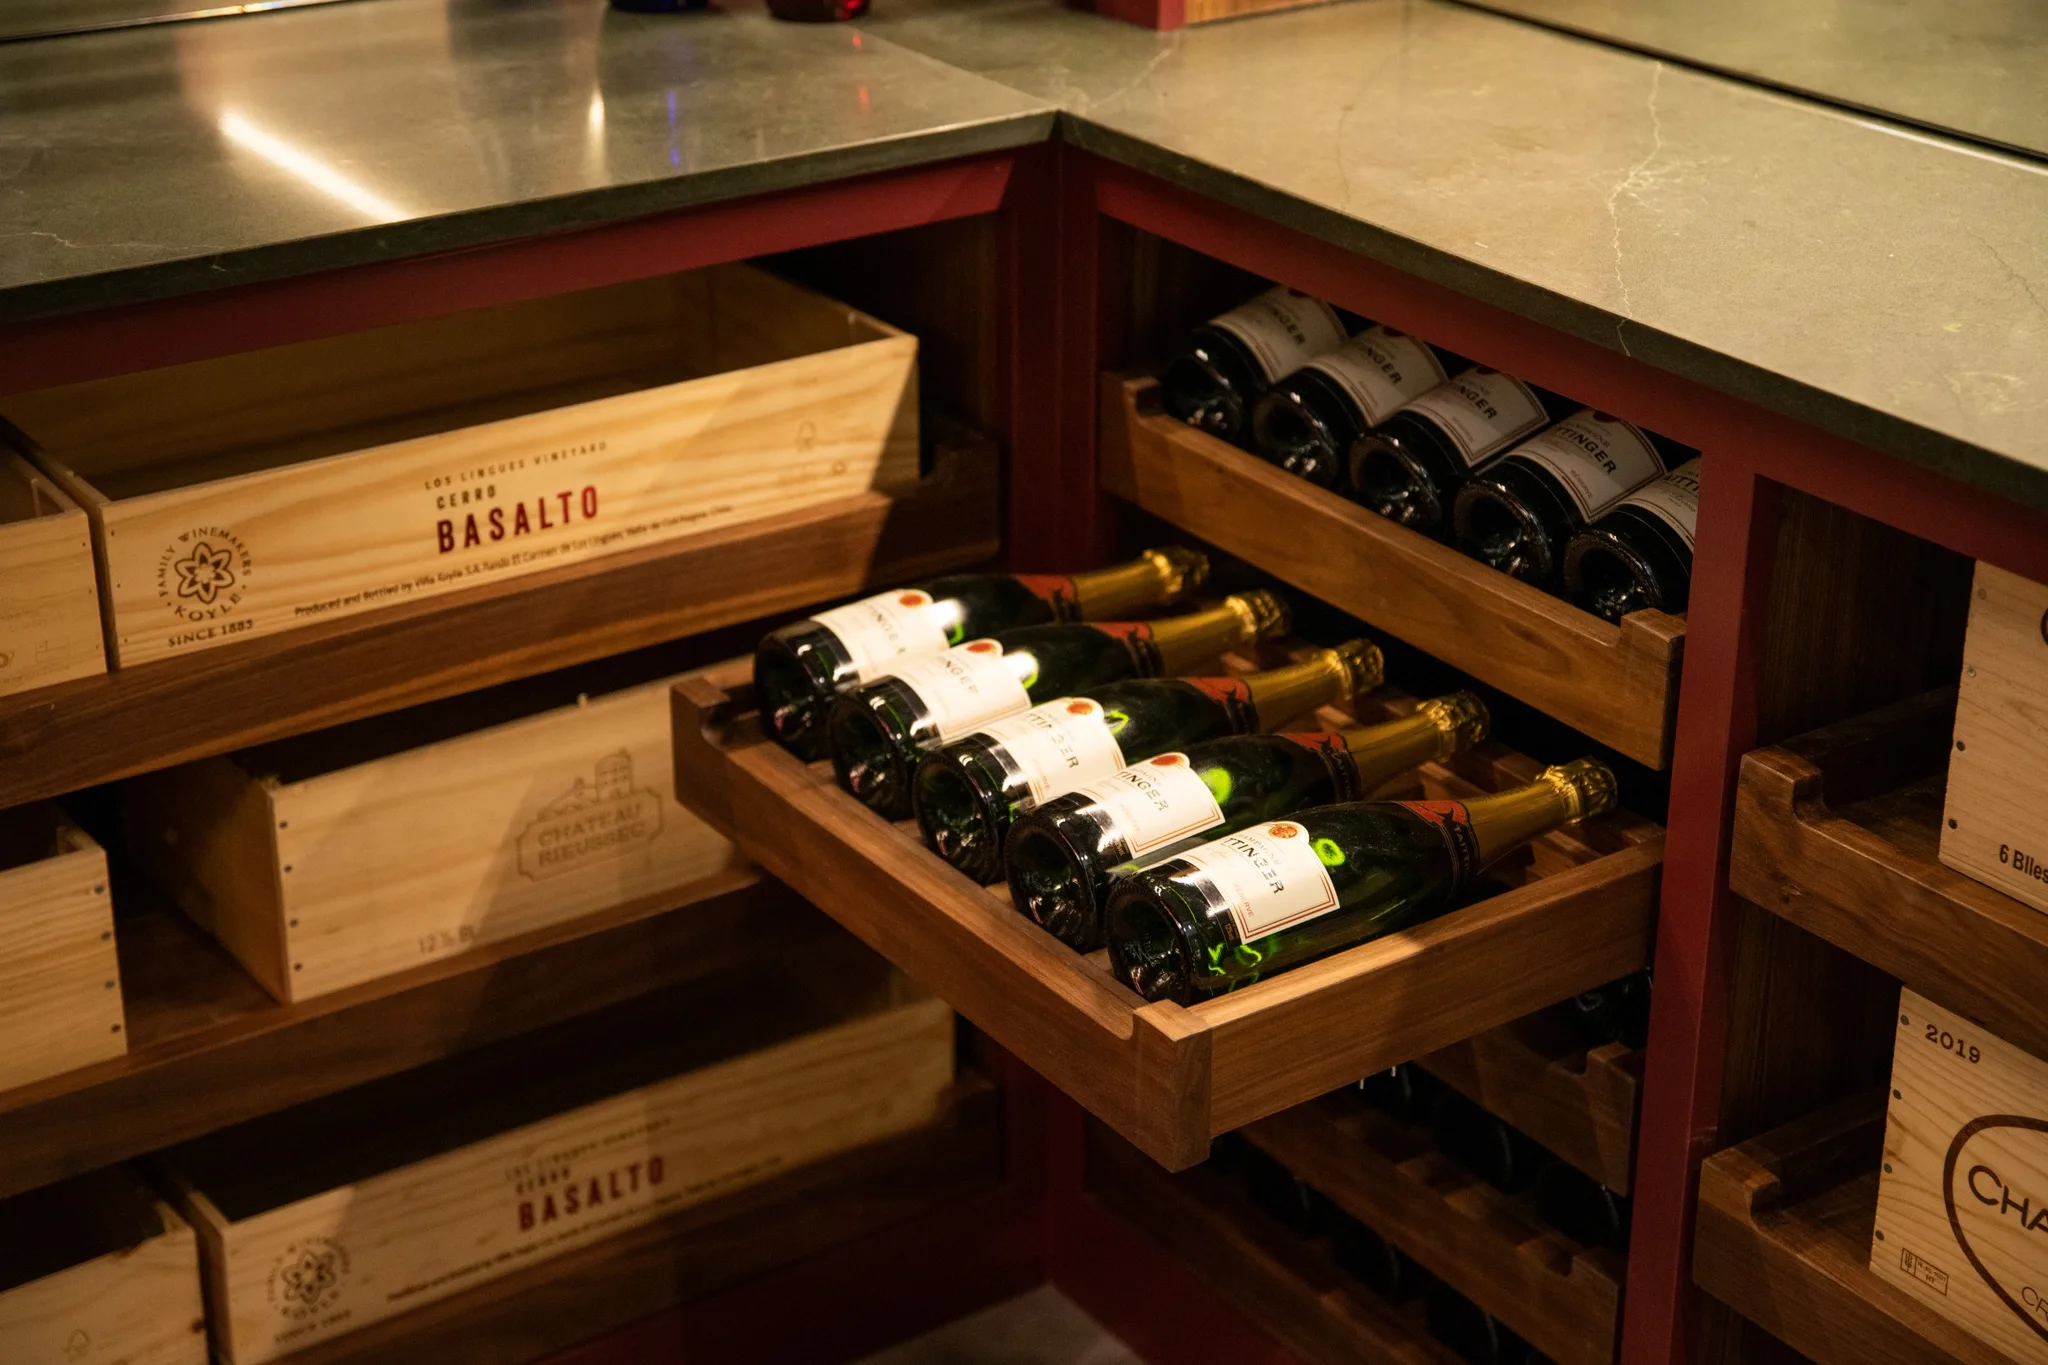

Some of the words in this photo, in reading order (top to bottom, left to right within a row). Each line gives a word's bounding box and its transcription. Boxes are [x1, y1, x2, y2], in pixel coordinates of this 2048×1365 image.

[425, 475, 452, 491] LOS
[534, 441, 607, 465] VINEYARD
[436, 484, 497, 510] CERRO
[436, 485, 598, 554] BASALTO
[157, 543, 176, 598] FAMILY
[177, 526, 252, 577] WINEMAKERS
[173, 592, 242, 622] KOYLE
[168, 626, 217, 647] SINCE
[1999, 844, 2009, 864] 6
[1925, 1024, 1980, 1064] 2019
[518, 1156, 663, 1233] BASALTO
